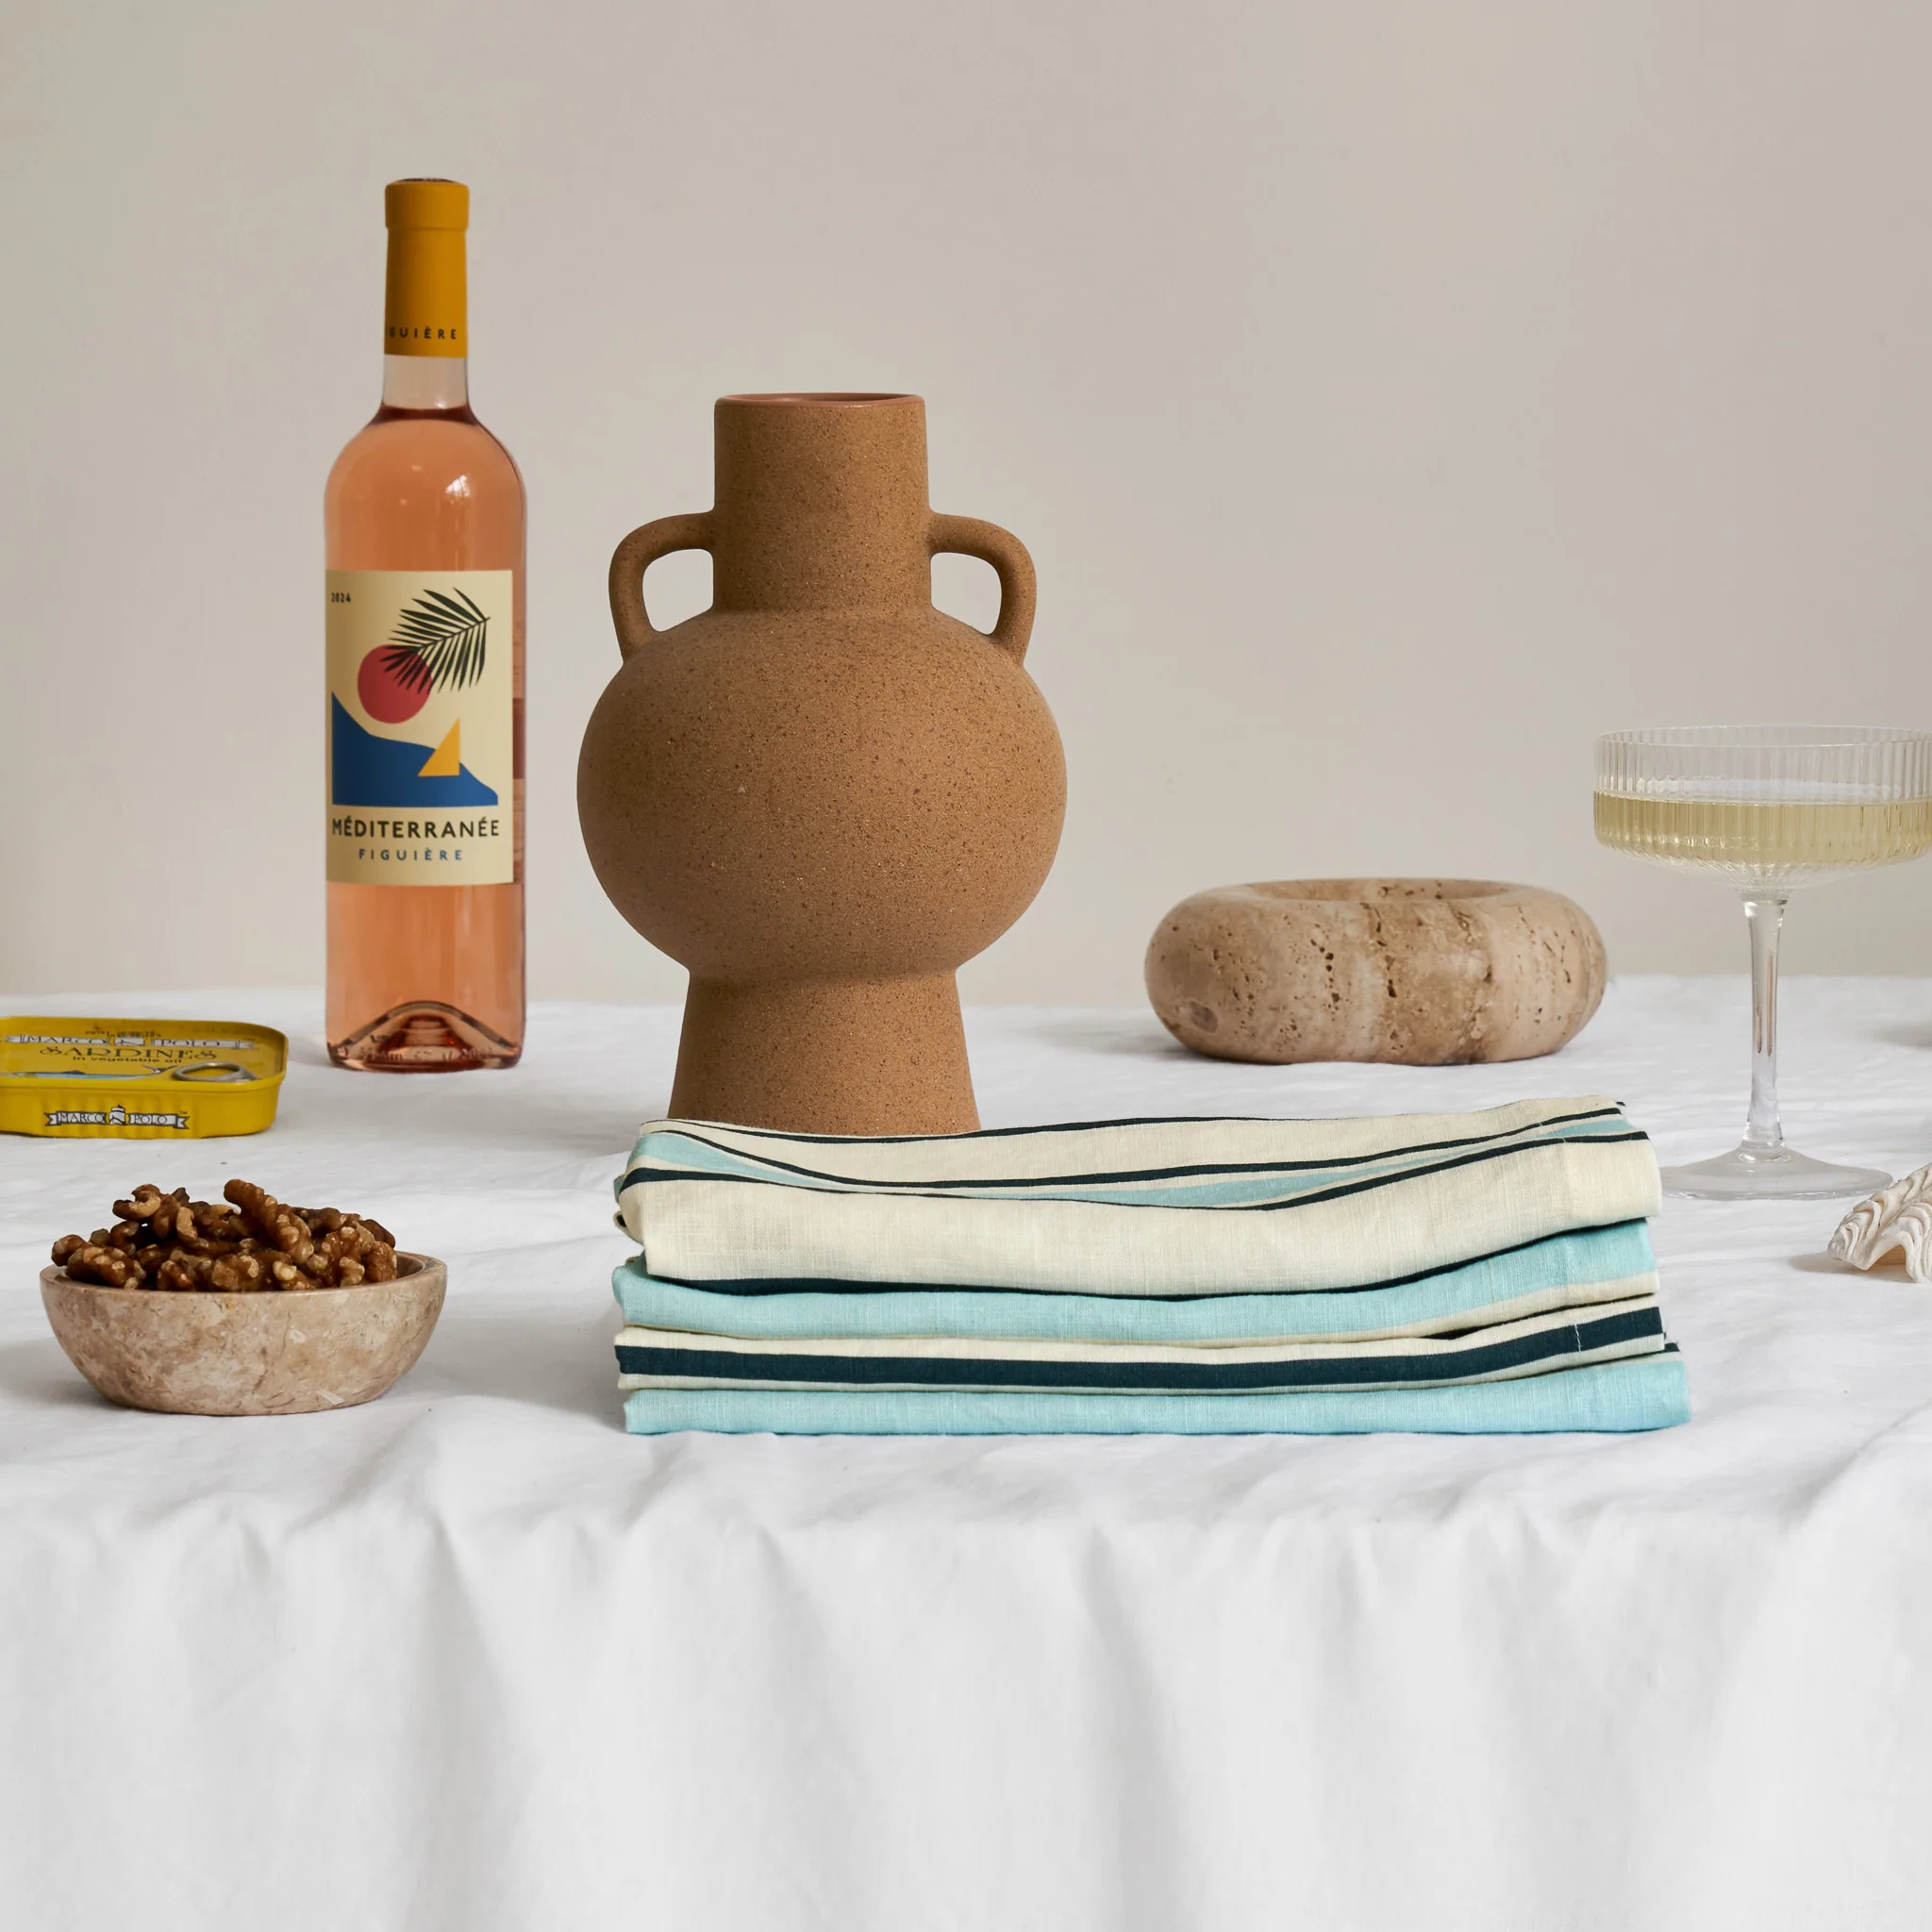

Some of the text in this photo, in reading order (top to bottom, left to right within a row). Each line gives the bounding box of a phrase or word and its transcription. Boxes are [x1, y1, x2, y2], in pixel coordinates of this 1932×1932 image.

[385, 325, 458, 341] GUIÈRE
[331, 591, 352, 604] 2024
[332, 815, 499, 839] MÉDITERRANÉE
[358, 847, 462, 861] FIGUIÈRE
[27, 1035, 221, 1047] MARCO POLO
[40, 1045, 217, 1059] SARDINES
[59, 1111, 168, 1125] MARCO POLO
